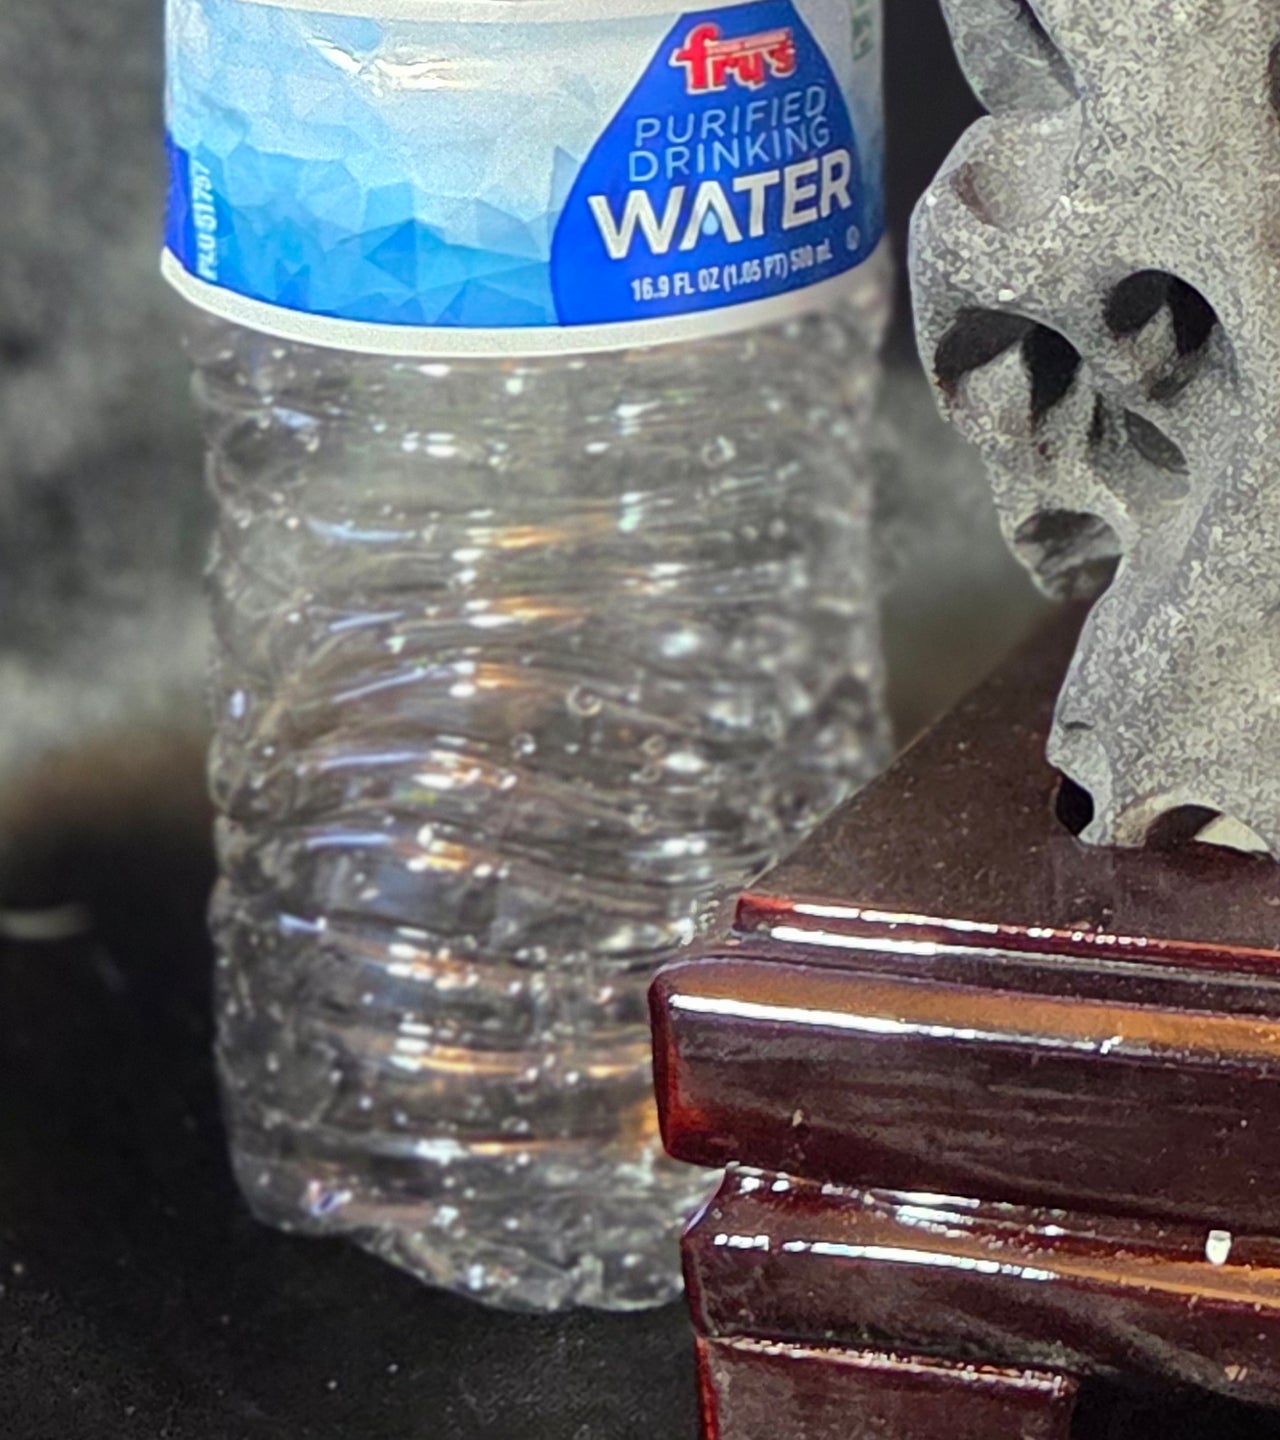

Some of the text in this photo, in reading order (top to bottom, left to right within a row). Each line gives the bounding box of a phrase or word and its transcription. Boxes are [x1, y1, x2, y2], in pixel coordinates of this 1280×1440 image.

[628, 115, 831, 183] DRINKING
[635, 85, 827, 148] PURIFIED
[587, 148, 853, 260] WATER
[631, 274, 669, 302] 16.9
[673, 271, 696, 296] FL
[698, 266, 721, 292] OZ
[723, 258, 762, 293] (1.05
[763, 252, 789, 280] PT)
